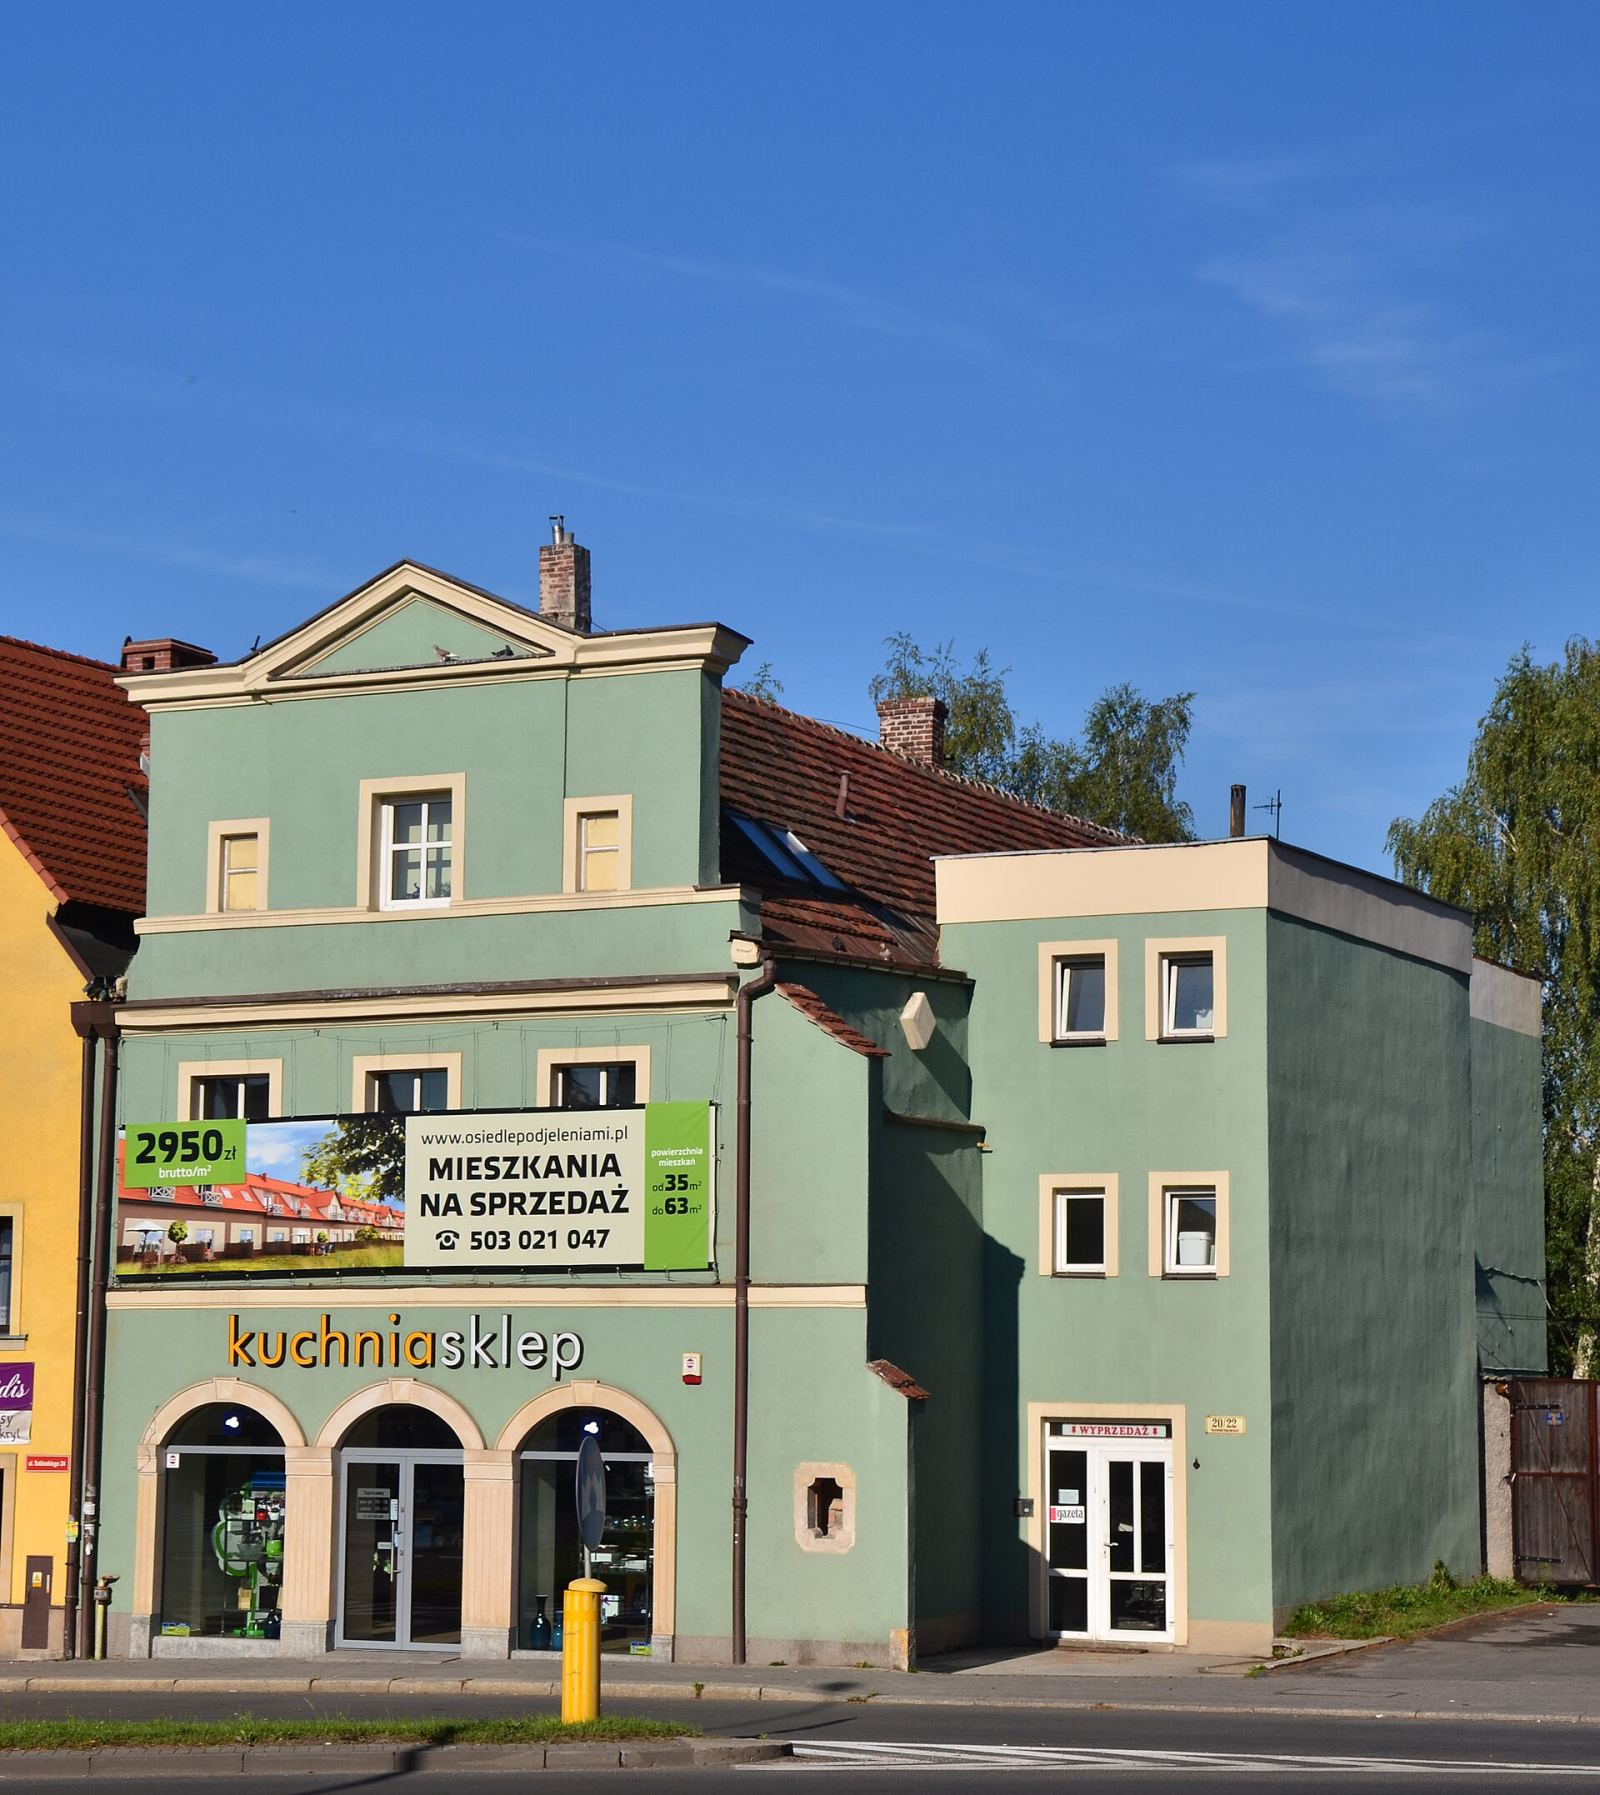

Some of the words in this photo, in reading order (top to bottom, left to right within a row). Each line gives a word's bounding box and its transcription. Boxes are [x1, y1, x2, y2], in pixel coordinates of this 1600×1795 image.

[421, 1126, 629, 1146] www.osiedlepodjeleniami.pl
[136, 1129, 223, 1164] 2950
[651, 1147, 703, 1158] powierzchnia
[429, 1153, 622, 1181] MIESZKANIA
[658, 1158, 696, 1167] mieszkań
[652, 1183, 664, 1192] od
[665, 1174, 688, 1191] 35
[420, 1193, 463, 1217] NA
[470, 1183, 629, 1216] SPRZEDAŻ
[652, 1206, 664, 1215] do
[665, 1197, 688, 1215] 63
[470, 1231, 511, 1250] 503
[518, 1230, 557, 1249] 021
[567, 1229, 610, 1249] 047
[229, 1313, 584, 1381] kuchniasklep
[0, 1373, 30, 1399] dis
[0, 1414, 14, 1428] sy
[1211, 1417, 1238, 1429] 20/22
[0, 1424, 20, 1442] kryl
[1057, 1508, 1083, 1521] gazeta
